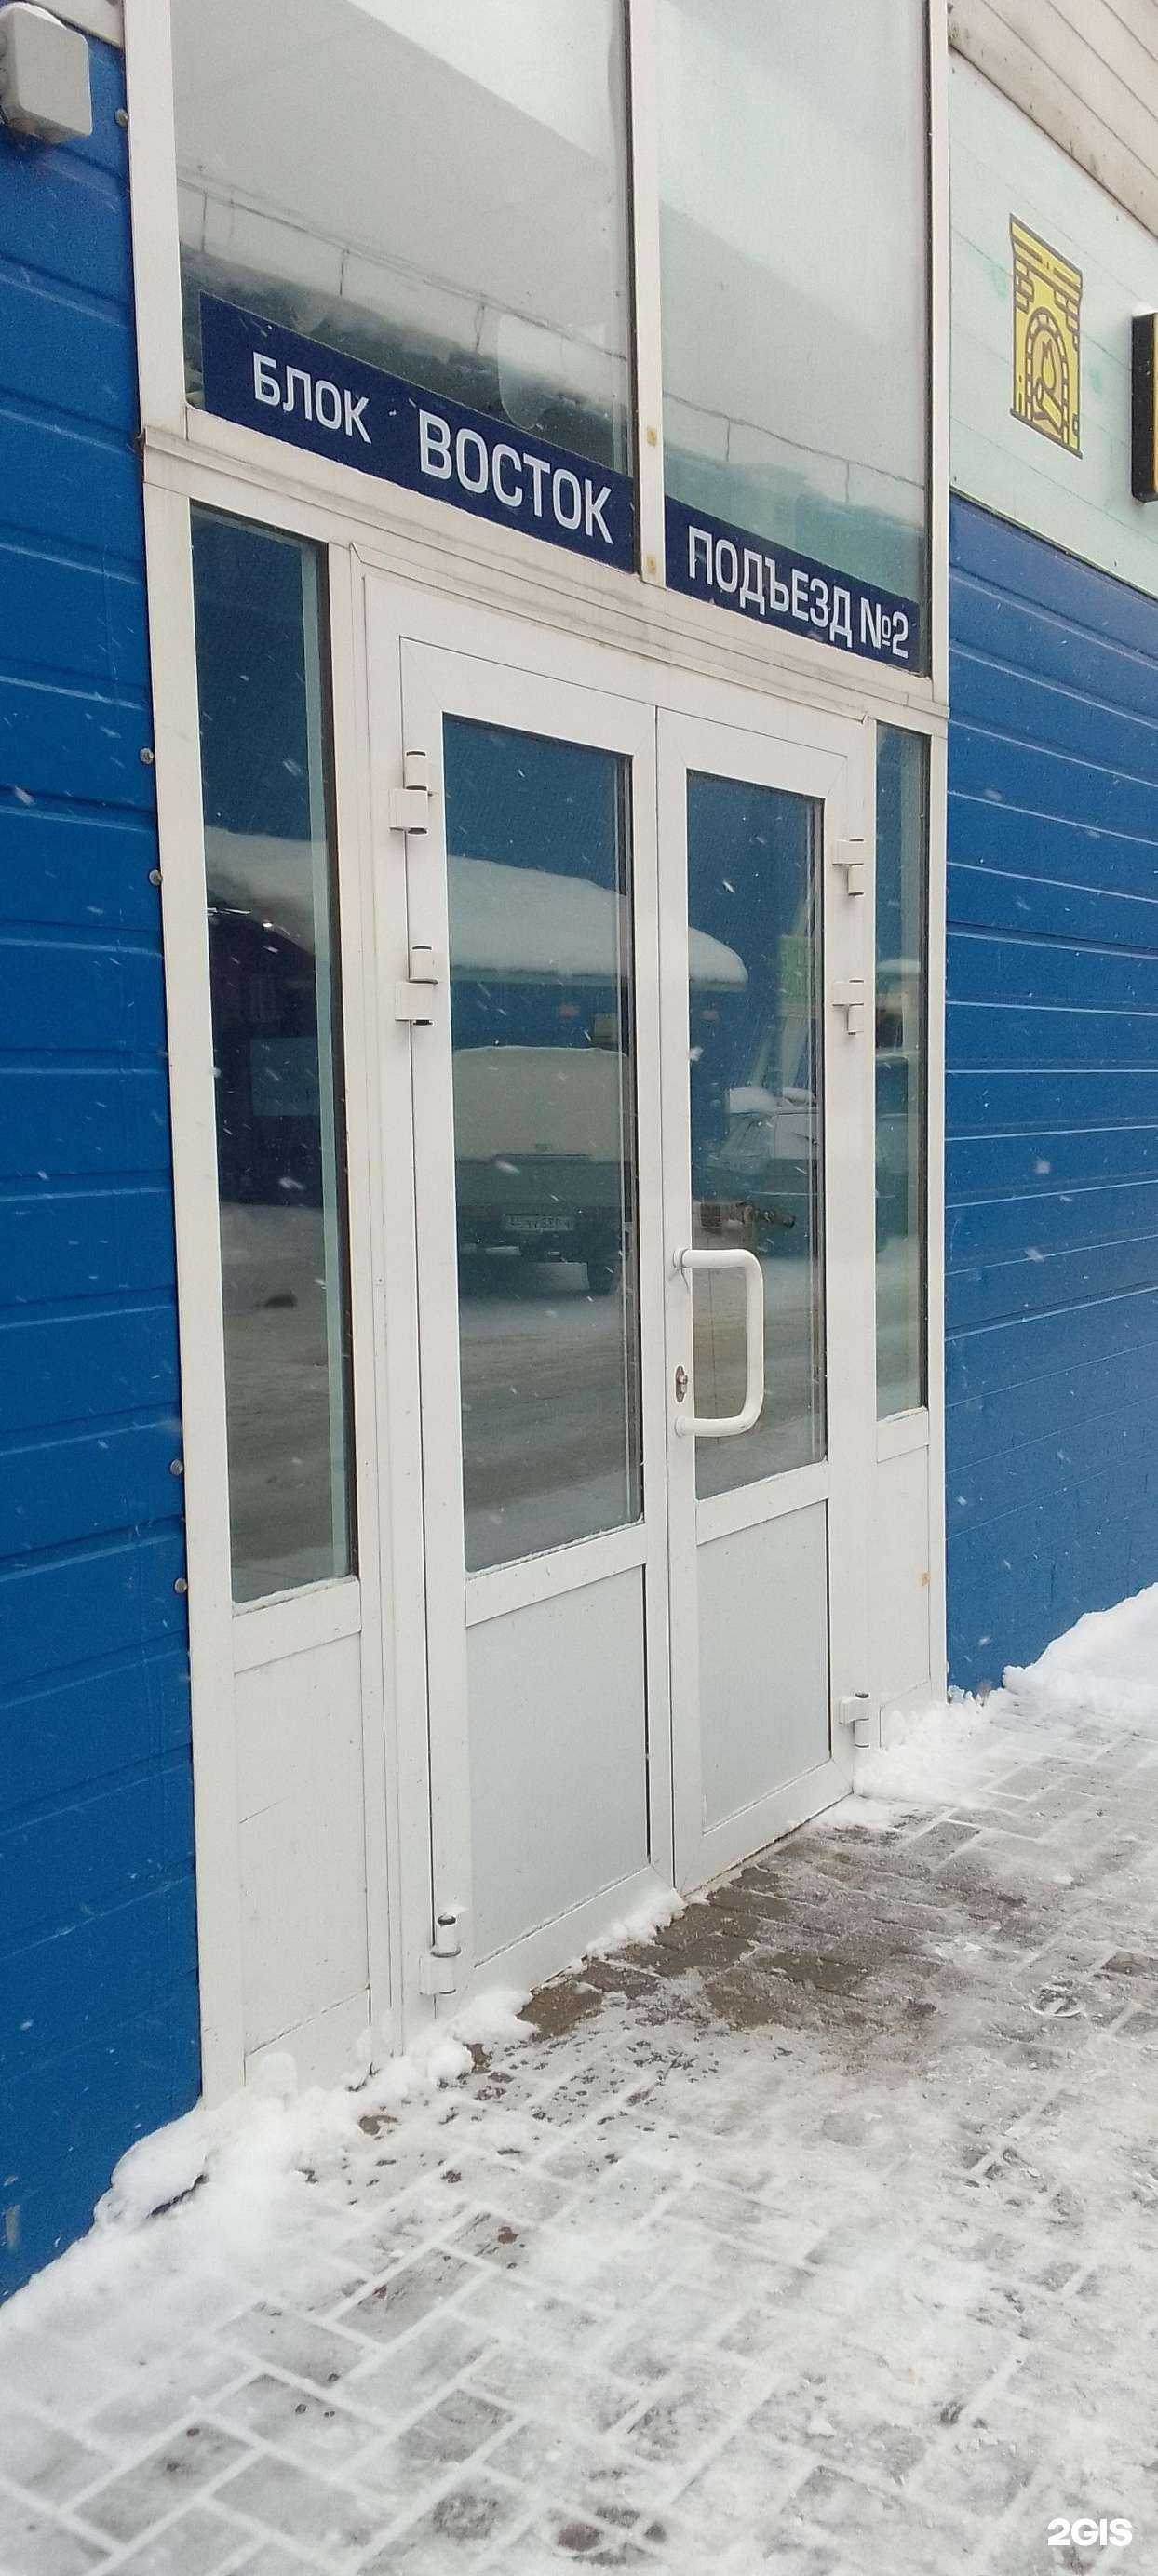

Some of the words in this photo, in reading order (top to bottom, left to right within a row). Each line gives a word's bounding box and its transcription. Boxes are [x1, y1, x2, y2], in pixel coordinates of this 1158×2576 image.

[252, 351, 372, 445] БЛОК
[419, 409, 614, 545] ВОСТОК
[688, 525, 853, 649] ПОДЪЕЗД
[860, 597, 909, 660] №2
